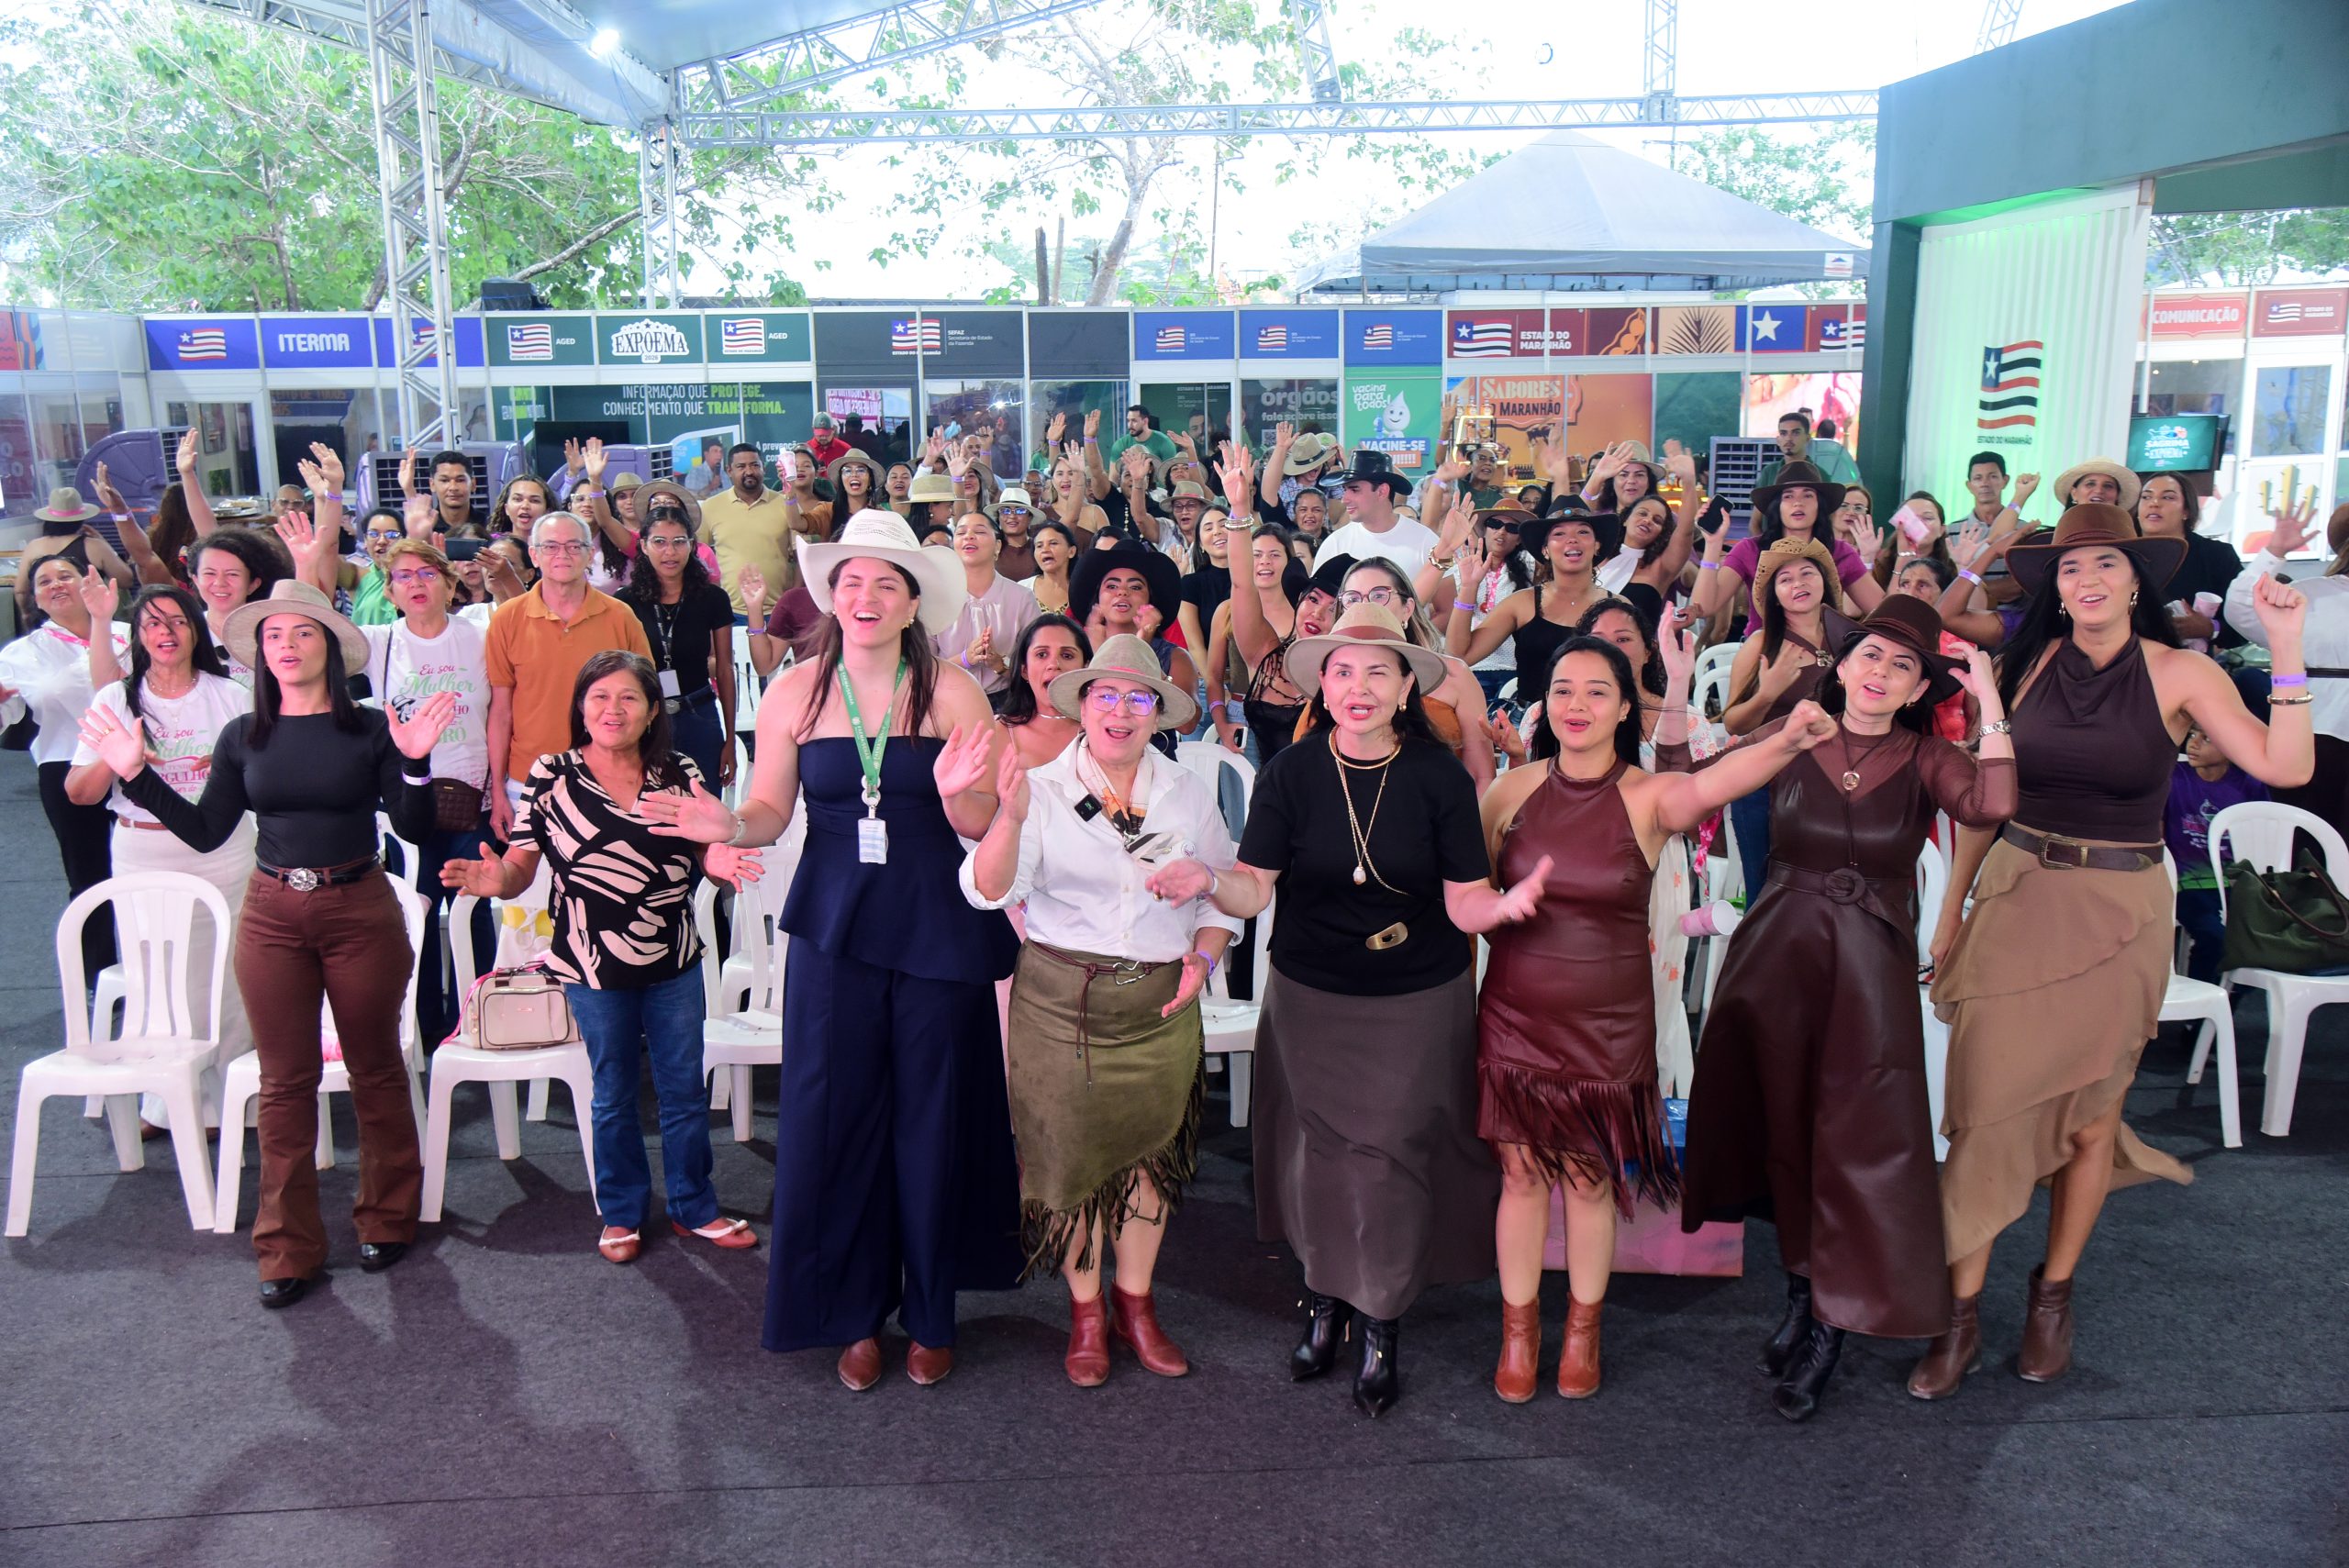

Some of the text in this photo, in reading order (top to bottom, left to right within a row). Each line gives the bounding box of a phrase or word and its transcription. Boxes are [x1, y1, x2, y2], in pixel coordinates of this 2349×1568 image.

[2153, 306, 2239, 324] COMUNICAÇÃO
[1556, 331, 1570, 339] DO
[278, 333, 350, 351] ITERMA
[615, 331, 686, 353] EXPOEMA
[688, 385, 708, 399] QUE
[1353, 384, 1386, 393] vacina
[1353, 392, 1384, 404] para
[1358, 395, 1391, 411] todos!
[604, 402, 681, 416] CONHECMENTO
[684, 402, 705, 417] QUE
[1262, 412, 1284, 421] fale
[1284, 412, 1316, 421] sobre
[1362, 440, 1426, 451] VACINE-SE
[419, 663, 455, 676] Eu sou
[399, 673, 476, 697] Mulher
[153, 726, 194, 739] Eu sou
